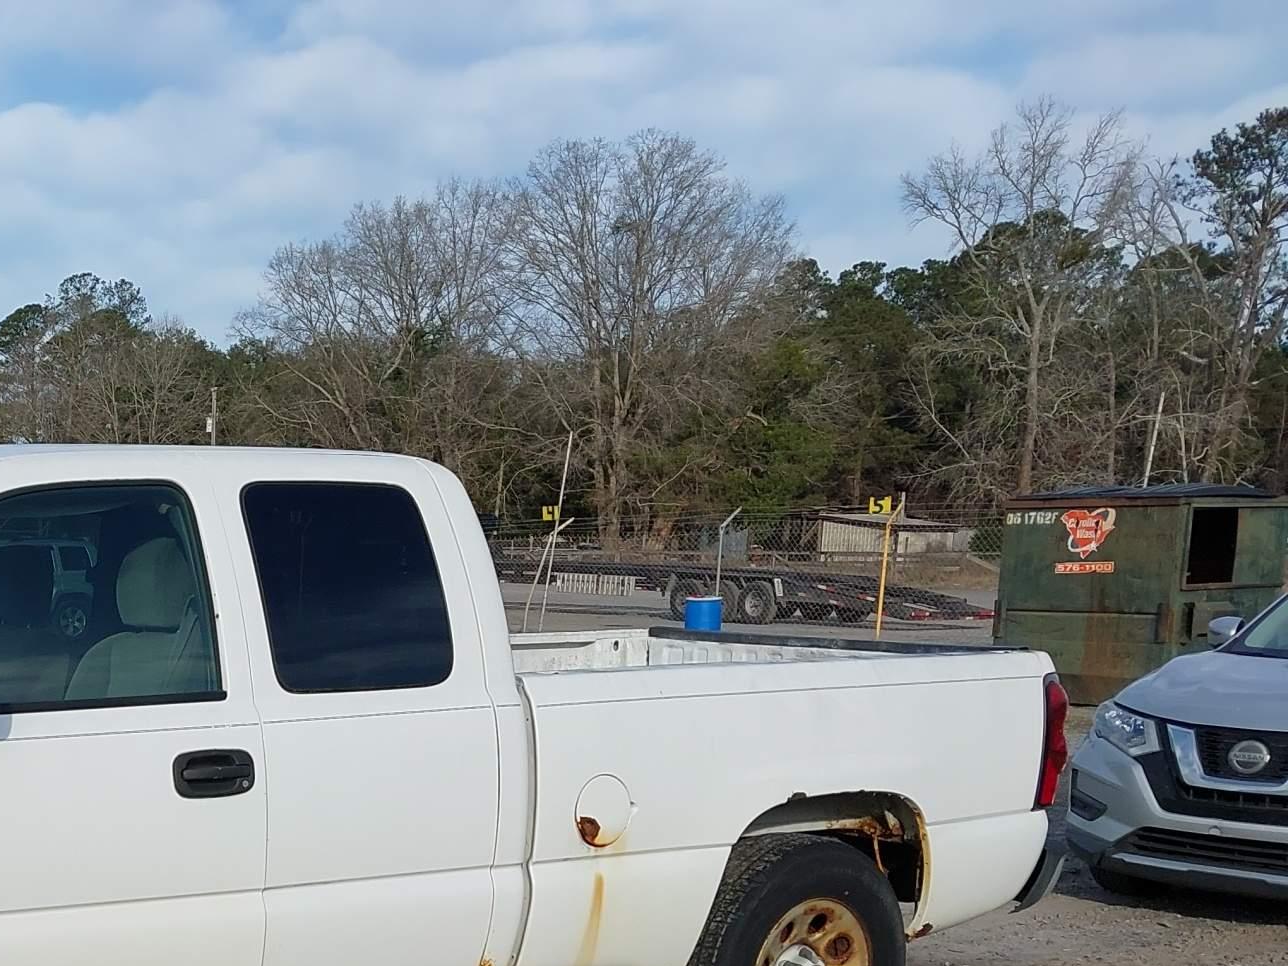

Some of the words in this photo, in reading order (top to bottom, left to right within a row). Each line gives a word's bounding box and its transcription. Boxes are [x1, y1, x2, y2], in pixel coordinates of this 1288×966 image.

[871, 497, 884, 514] 5
[1069, 517, 1101, 528] Crolin
[1076, 528, 1101, 538] Wase
[1057, 563, 1112, 572] 576-1100
[1231, 752, 1264, 760] NISSAN
